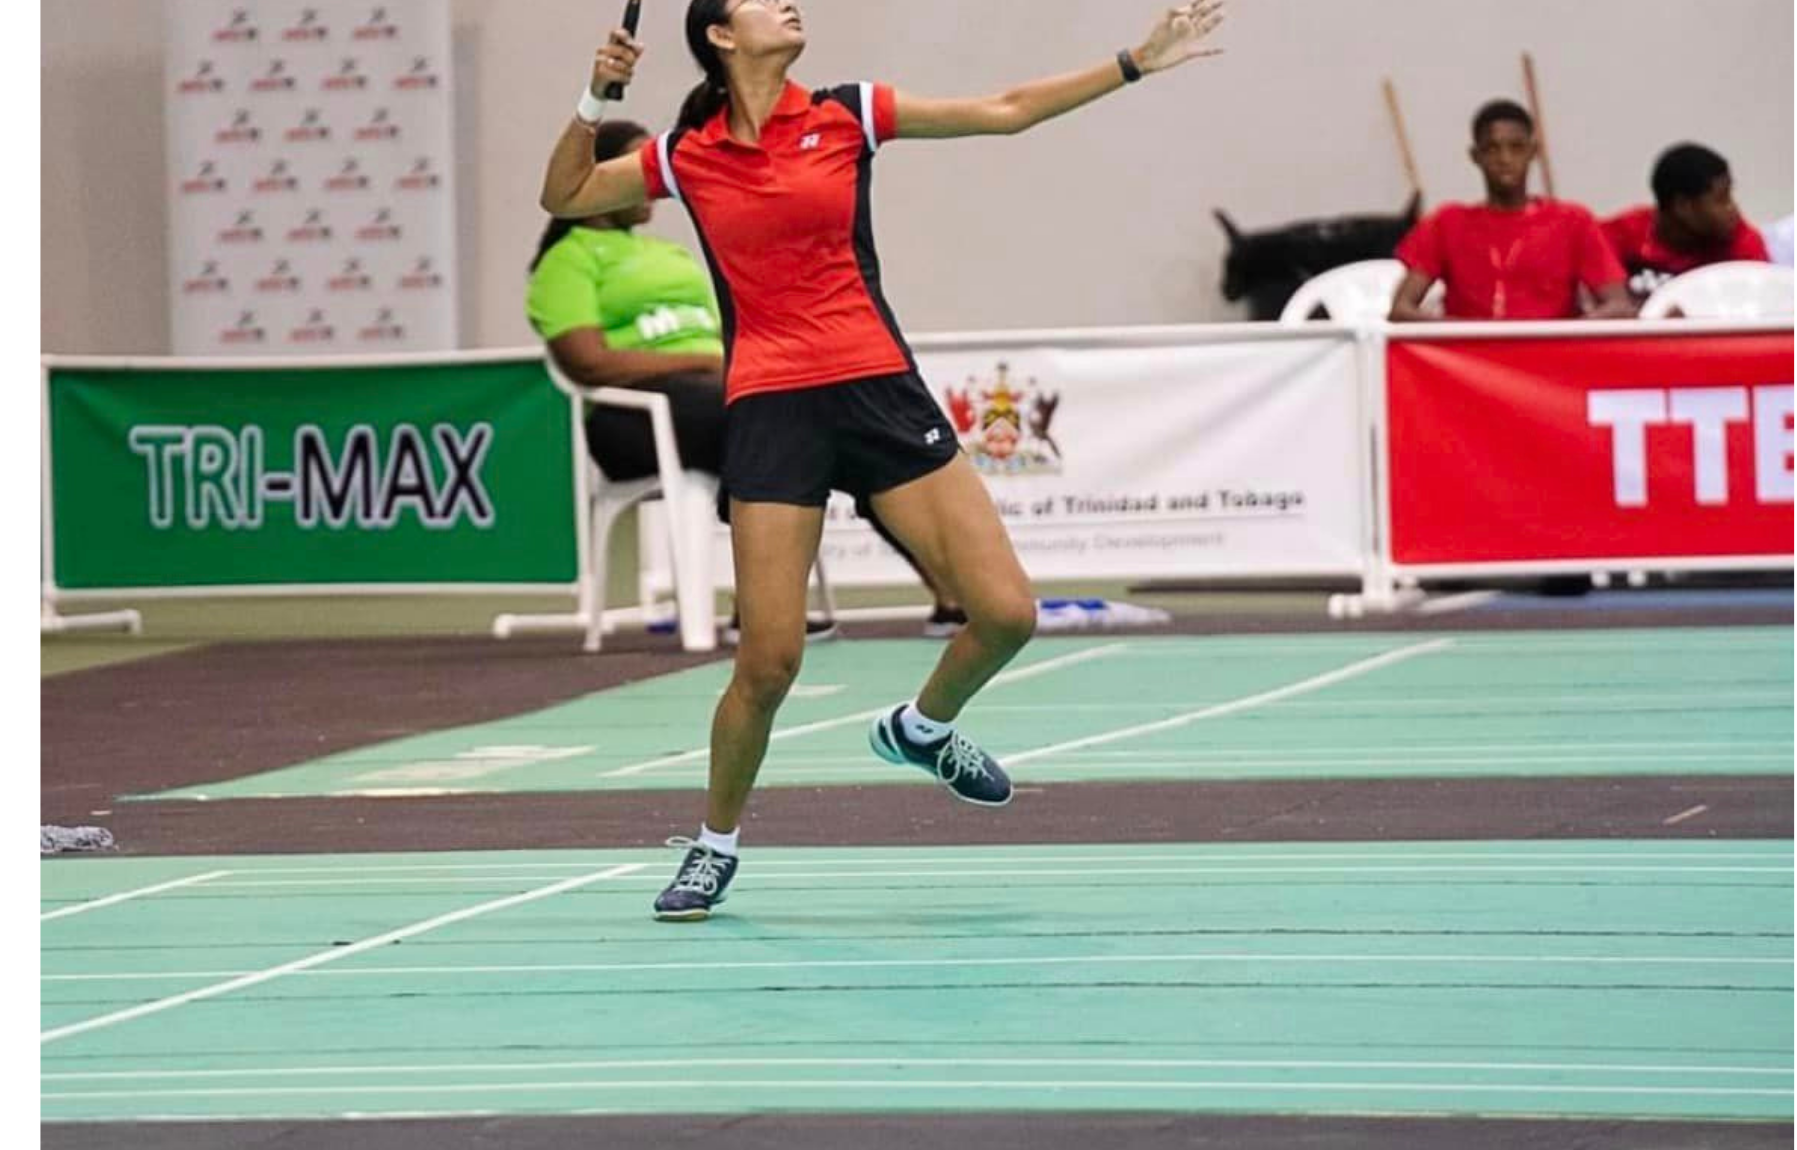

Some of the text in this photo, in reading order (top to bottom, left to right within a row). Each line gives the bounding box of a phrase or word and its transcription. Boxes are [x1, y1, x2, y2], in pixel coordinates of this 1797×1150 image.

[130, 424, 494, 528] TRI-MAX
[1030, 496, 1054, 517] of
[1062, 493, 1158, 515] Trinidad
[1167, 493, 1209, 512] and
[1217, 489, 1306, 512] Tobago
